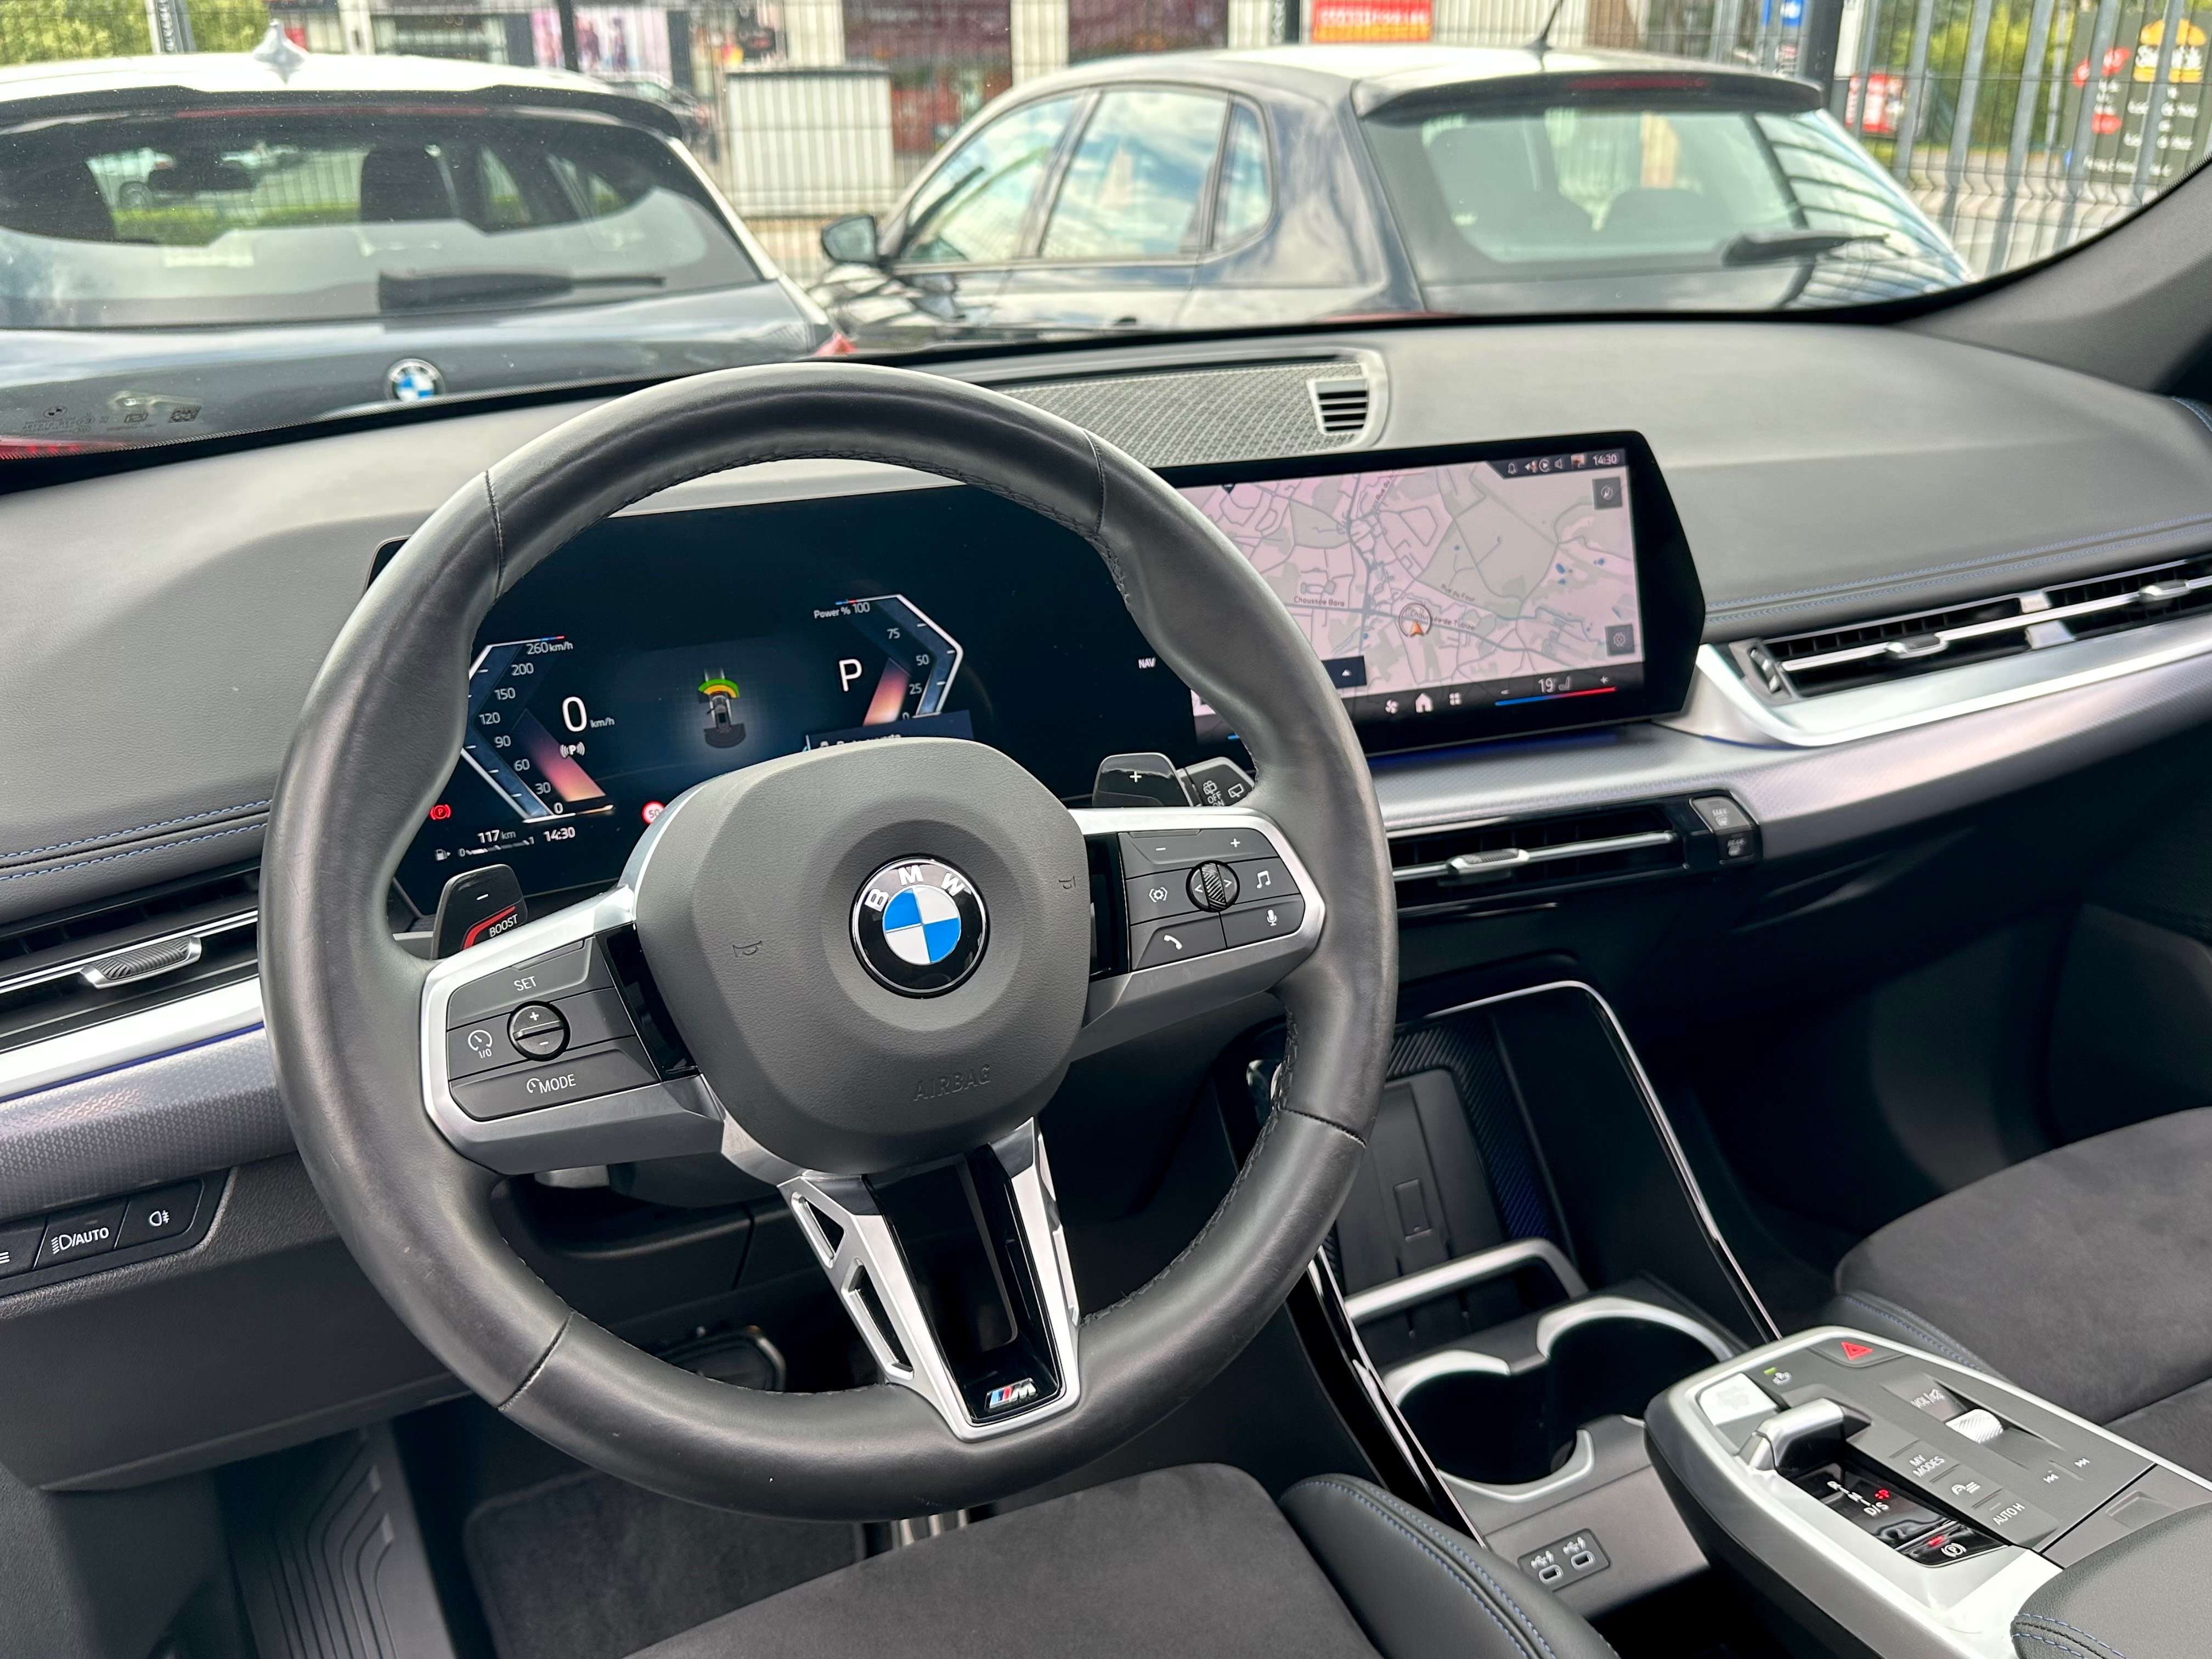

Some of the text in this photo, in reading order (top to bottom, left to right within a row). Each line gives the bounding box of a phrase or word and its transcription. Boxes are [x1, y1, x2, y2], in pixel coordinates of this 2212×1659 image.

[1593, 452, 1619, 466] 14:30
[814, 602, 871, 619] Power % 100
[887, 628, 900, 639] 75
[527, 641, 574, 655] 260 km/h
[916, 654, 929, 667] 50
[1138, 657, 1156, 669] NAV
[511, 662, 534, 676] 200
[839, 658, 862, 692] P
[495, 687, 516, 701] 150
[909, 683, 922, 695] 25
[479, 712, 500, 725] 120
[562, 696, 615, 732] 0 km/h
[495, 735, 511, 748] 90
[514, 759, 531, 771] 60
[534, 782, 551, 795] 30
[1207, 791, 1222, 804] OFF
[554, 802, 563, 815] 0
[648, 809, 659, 819] 50
[477, 830, 516, 844] 117 km
[544, 827, 576, 842] 14:30
[458, 848, 466, 857] 0
[865, 865, 966, 912] BMW
[489, 913, 518, 938] BOOST
[514, 976, 537, 991] SET
[539, 1074, 576, 1093] MODE
[913, 1064, 991, 1102] AIRBAG
[1909, 1454, 1926, 1467] MY
[1912, 1455, 1945, 1477] MODES
[1863, 1502, 1889, 1517] D/S
[1993, 1503, 2025, 1526] AUTO H
